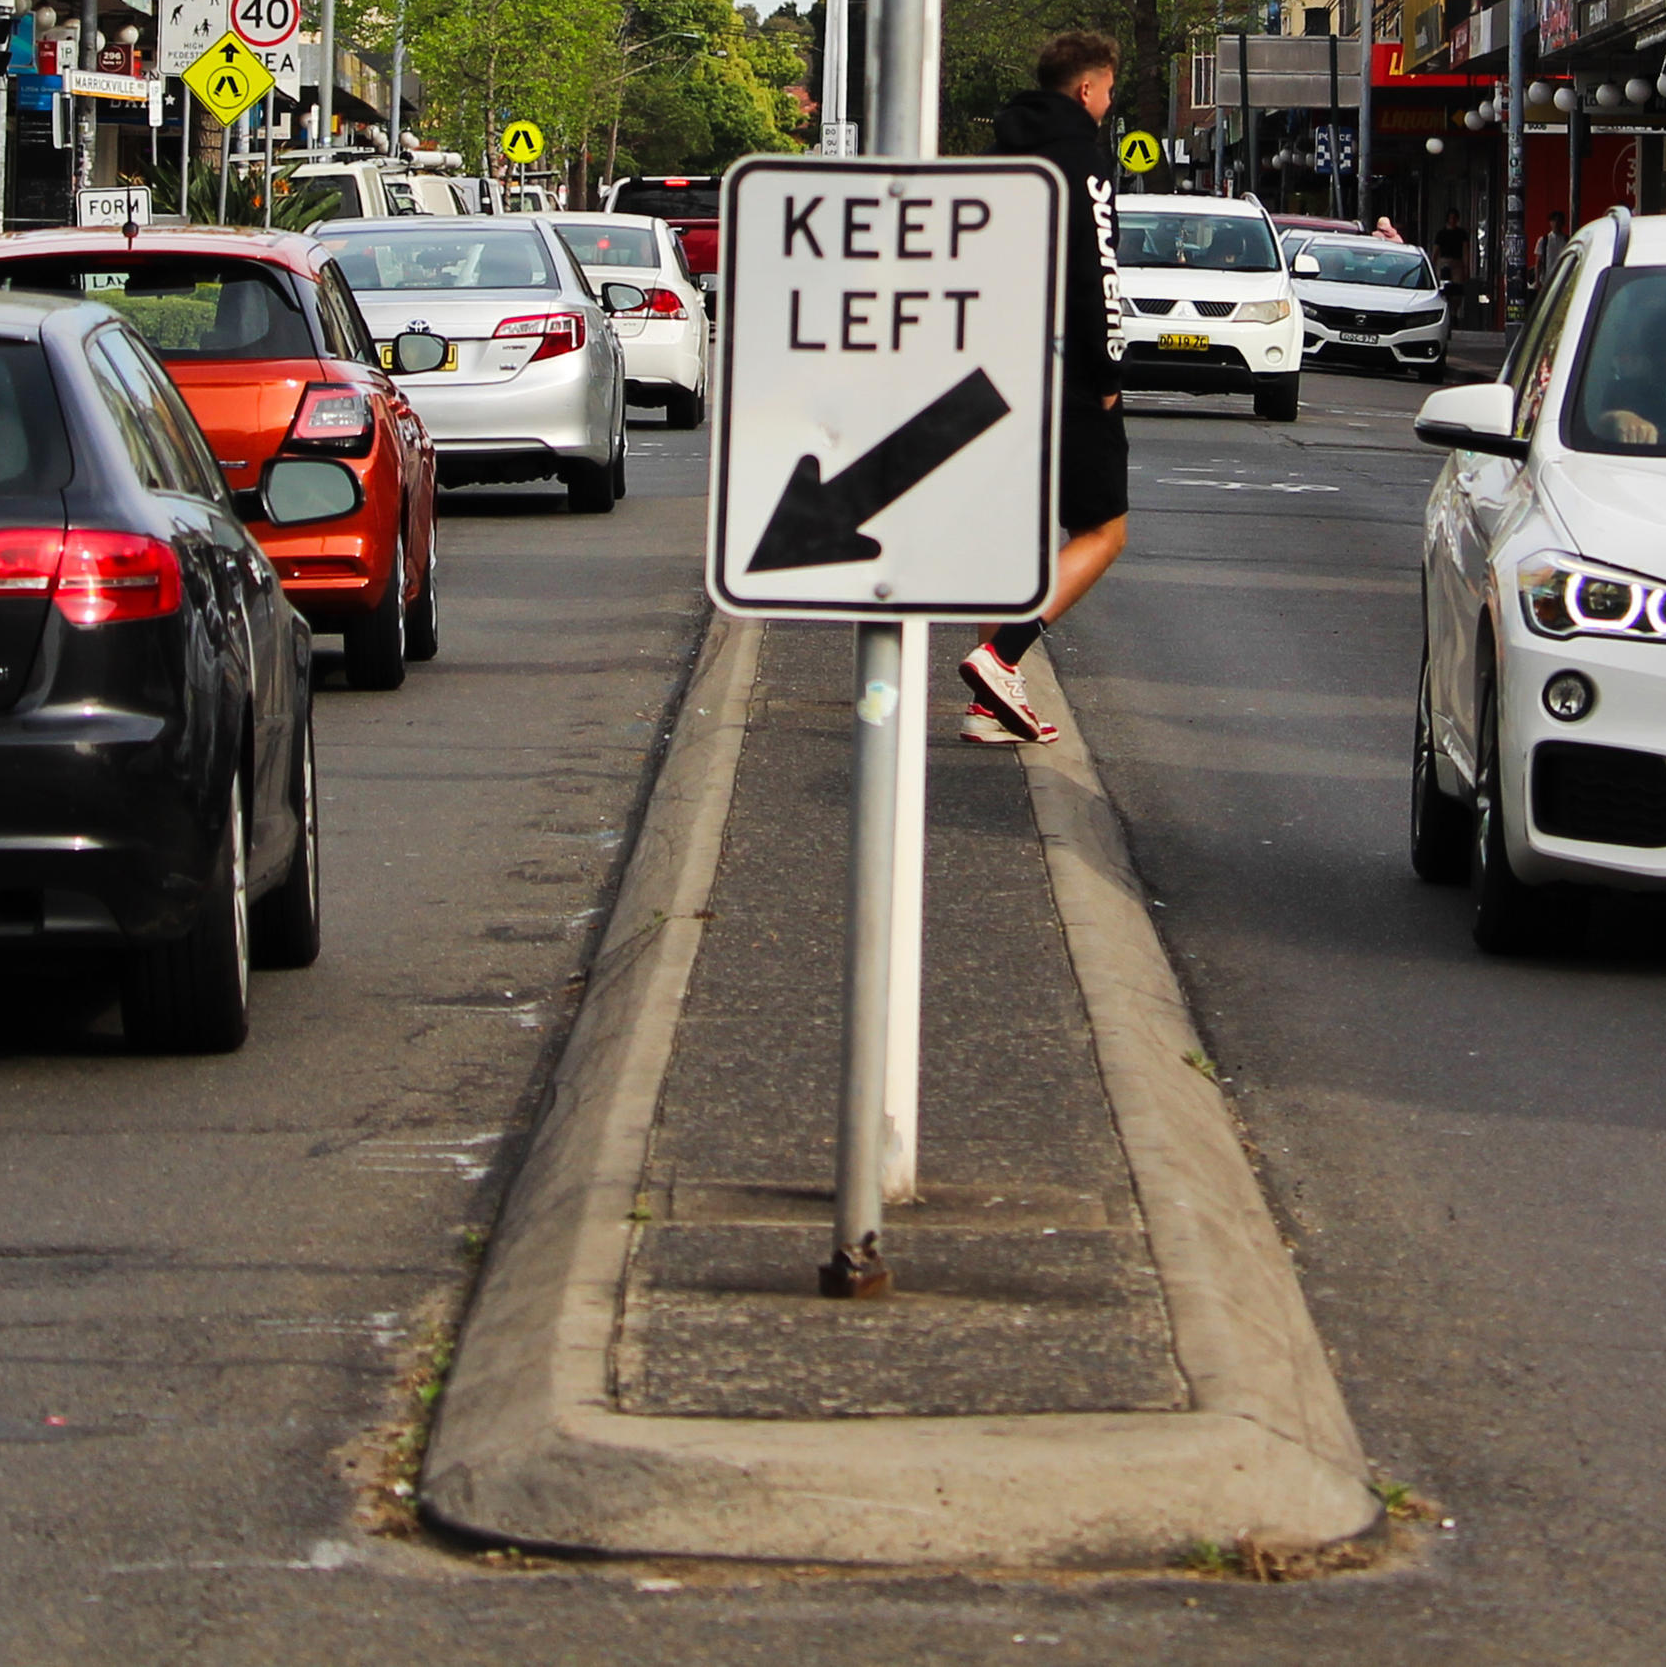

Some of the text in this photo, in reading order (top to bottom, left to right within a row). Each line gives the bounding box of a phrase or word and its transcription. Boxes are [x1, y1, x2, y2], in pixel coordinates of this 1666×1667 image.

[60, 46, 73, 59] 1P
[75, 76, 136, 94] MARRICKVILLE
[90, 199, 140, 215] FORM
[781, 195, 992, 260] KEEP
[788, 288, 981, 352] LEFT
